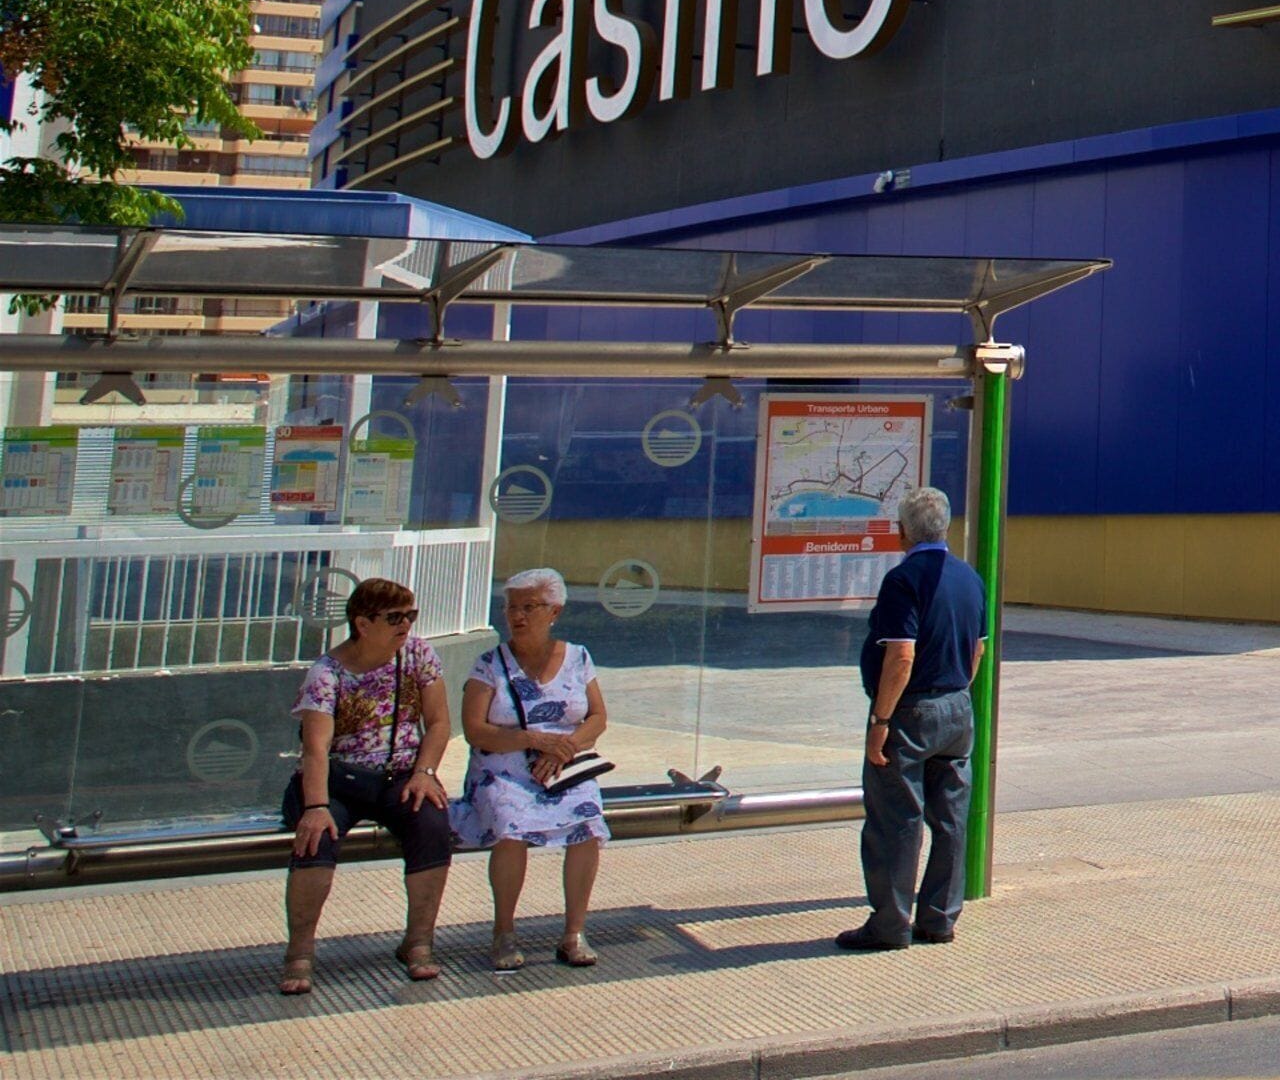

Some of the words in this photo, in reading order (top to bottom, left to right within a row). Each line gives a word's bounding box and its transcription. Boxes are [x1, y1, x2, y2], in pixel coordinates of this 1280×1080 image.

[808, 404, 855, 414] Transporte
[858, 404, 889, 413] Urbano
[278, 428, 292, 438] 30
[806, 541, 860, 552] Benidorm
